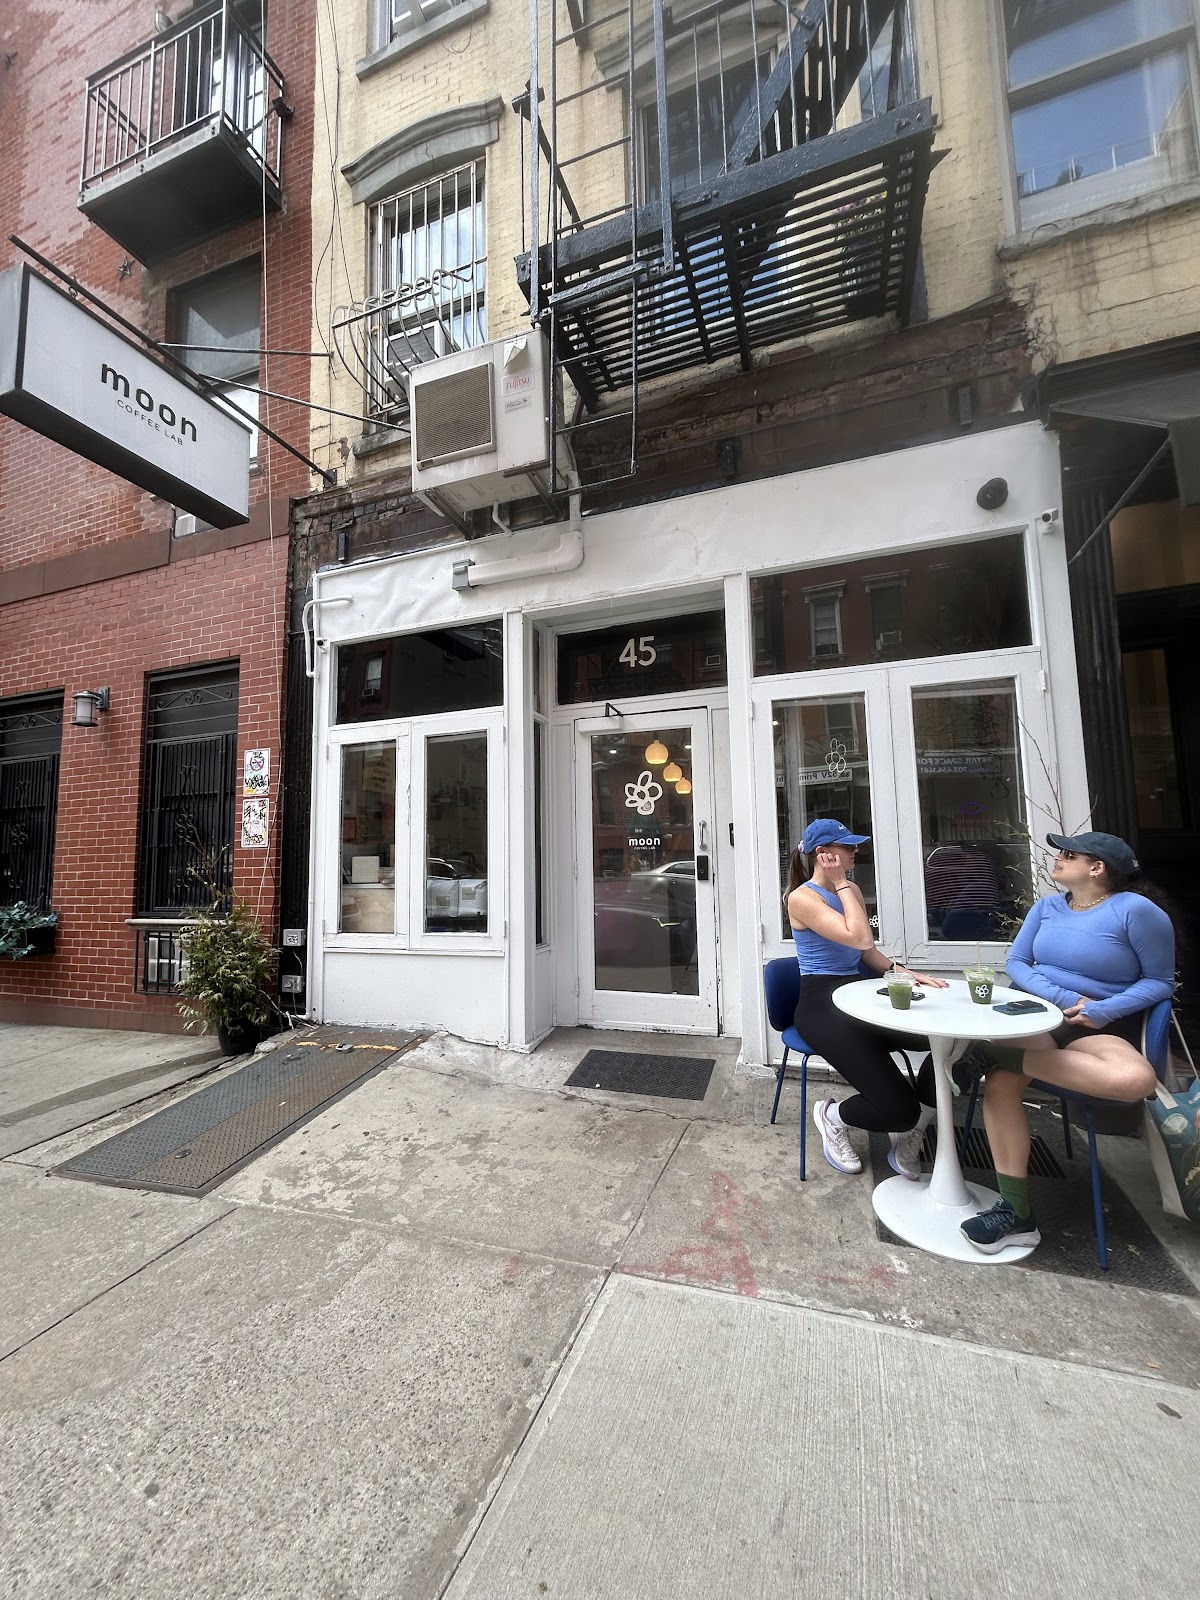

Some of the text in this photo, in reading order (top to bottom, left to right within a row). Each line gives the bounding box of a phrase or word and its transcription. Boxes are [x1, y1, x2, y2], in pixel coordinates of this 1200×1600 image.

[101, 363, 197, 442] moon
[117, 399, 183, 445] COFFEE LAB
[618, 635, 657, 668] 45
[628, 837, 661, 846] moon
